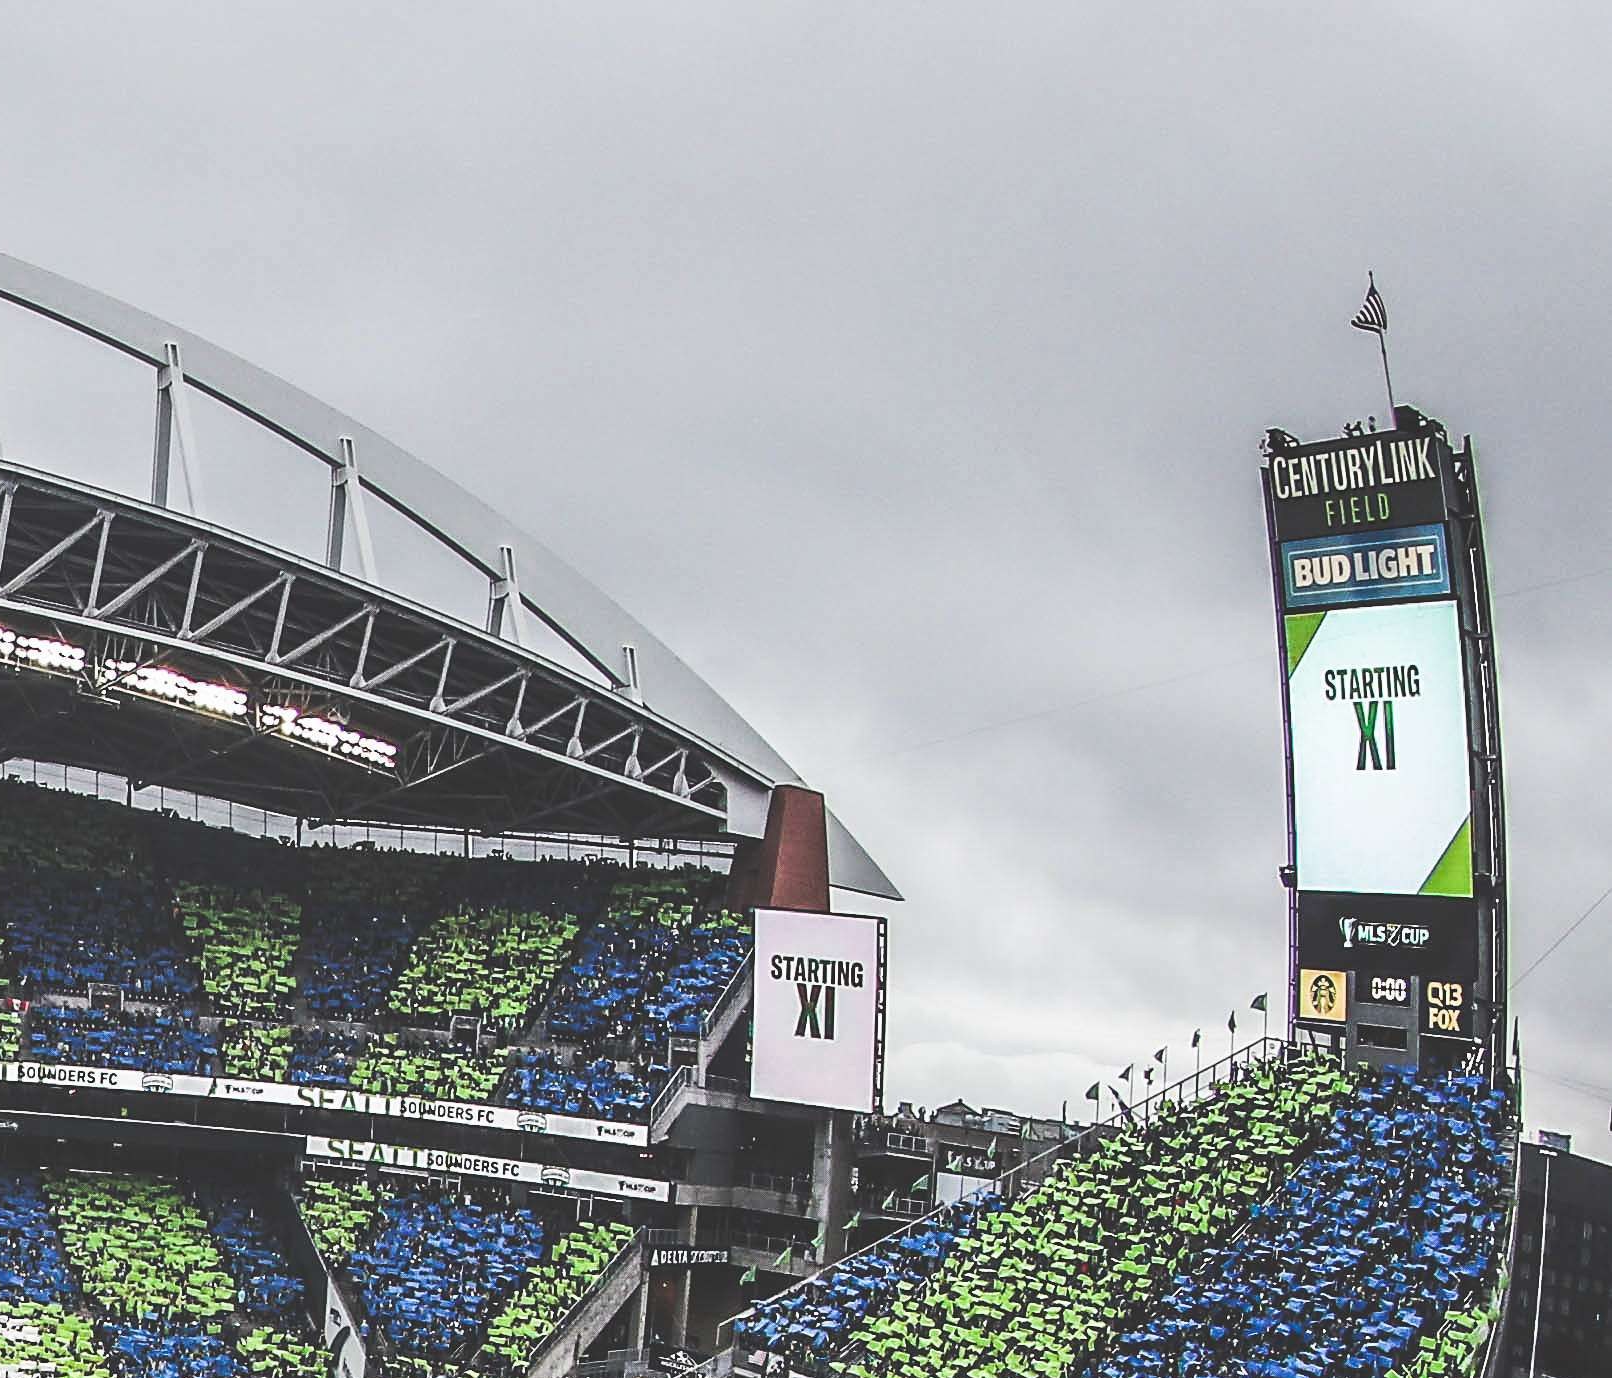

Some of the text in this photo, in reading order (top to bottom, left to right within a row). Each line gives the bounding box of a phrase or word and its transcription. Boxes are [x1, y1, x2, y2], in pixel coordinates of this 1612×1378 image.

[1273, 438, 1436, 500] CENTURYLINK
[1326, 493, 1390, 527] FIELD
[1294, 545, 1436, 588] BUD LIGHT
[1325, 664, 1420, 701] STARTING
[1353, 700, 1396, 771] XI
[1358, 924, 1429, 945] MLS CUP
[770, 954, 864, 988] STARTING
[1372, 977, 1406, 1001] 0:00
[1427, 982, 1463, 1007] Q13
[794, 982, 836, 1041] XI
[1429, 1007, 1461, 1031] FOX
[17, 1061, 118, 1086] SOUNDERS FC
[400, 1098, 494, 1124] SOUNDERS FC
[427, 1152, 520, 1177] SOUNDERS FC
[661, 1250, 688, 1264] DELTA
